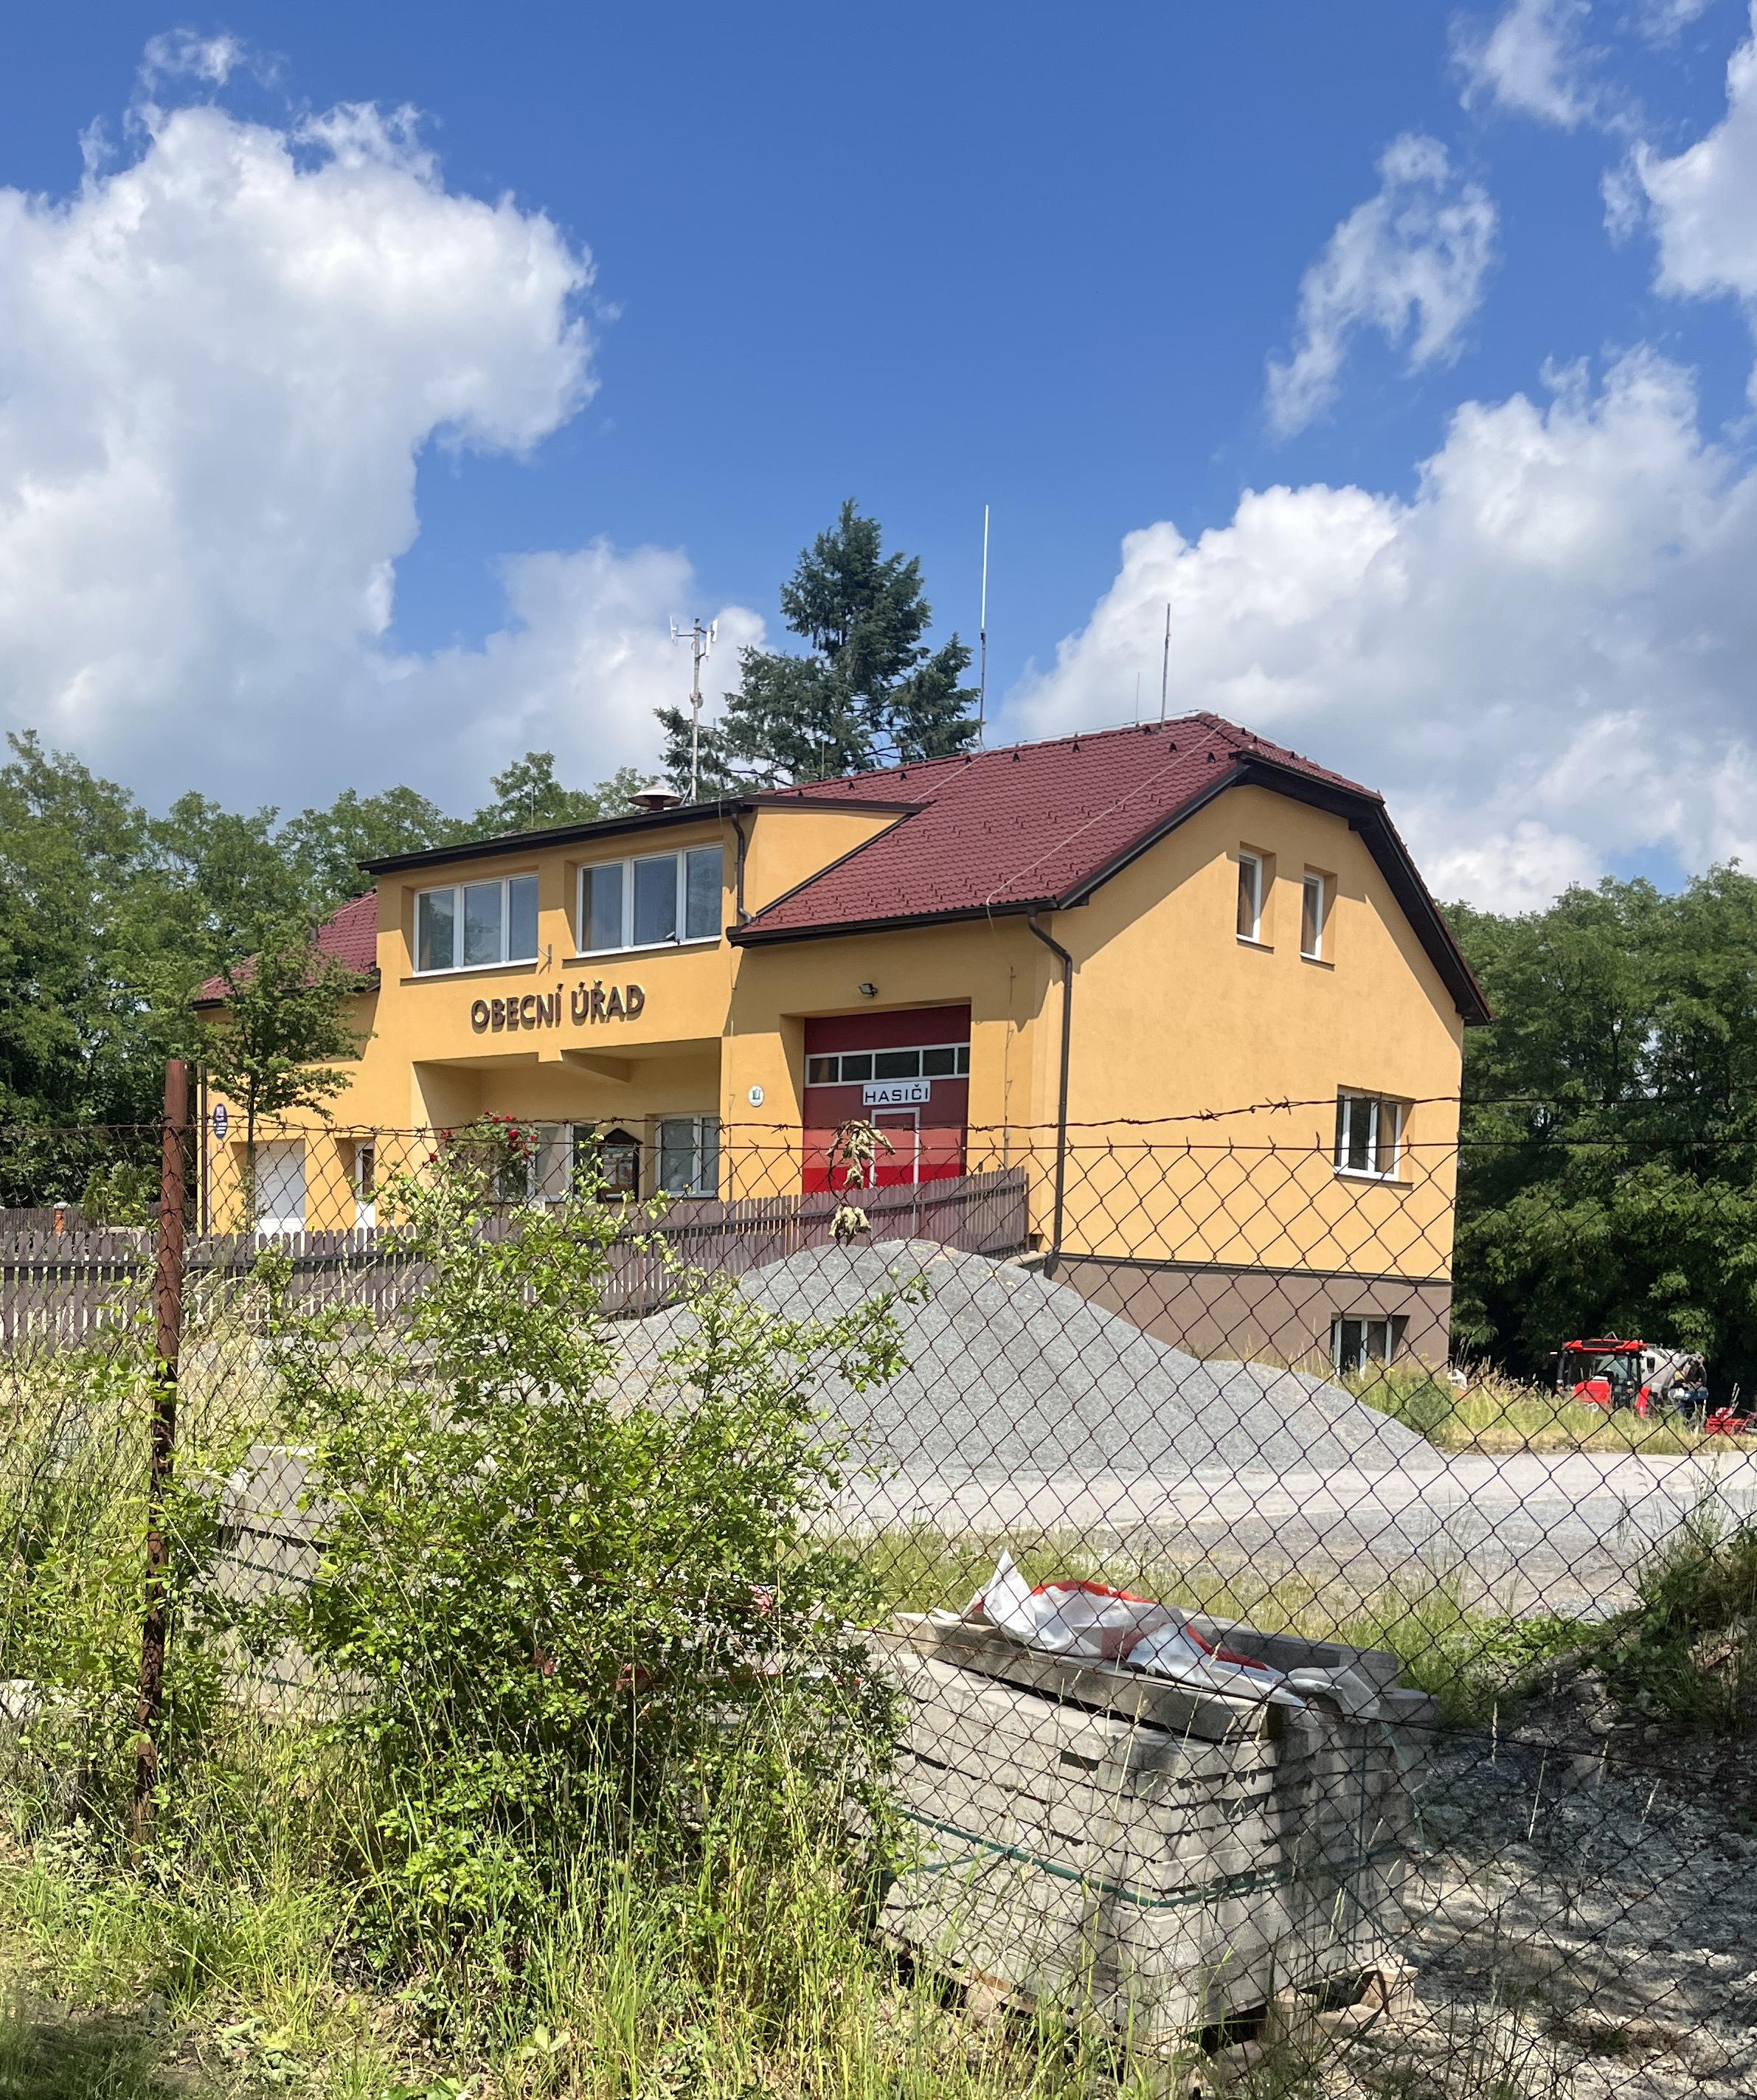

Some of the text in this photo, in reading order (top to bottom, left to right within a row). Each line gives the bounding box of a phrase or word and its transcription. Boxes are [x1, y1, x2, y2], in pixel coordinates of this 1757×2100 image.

[471, 980, 645, 1033] OBECNÍ ÚŘAD
[864, 1084, 929, 1103] HASIČI
